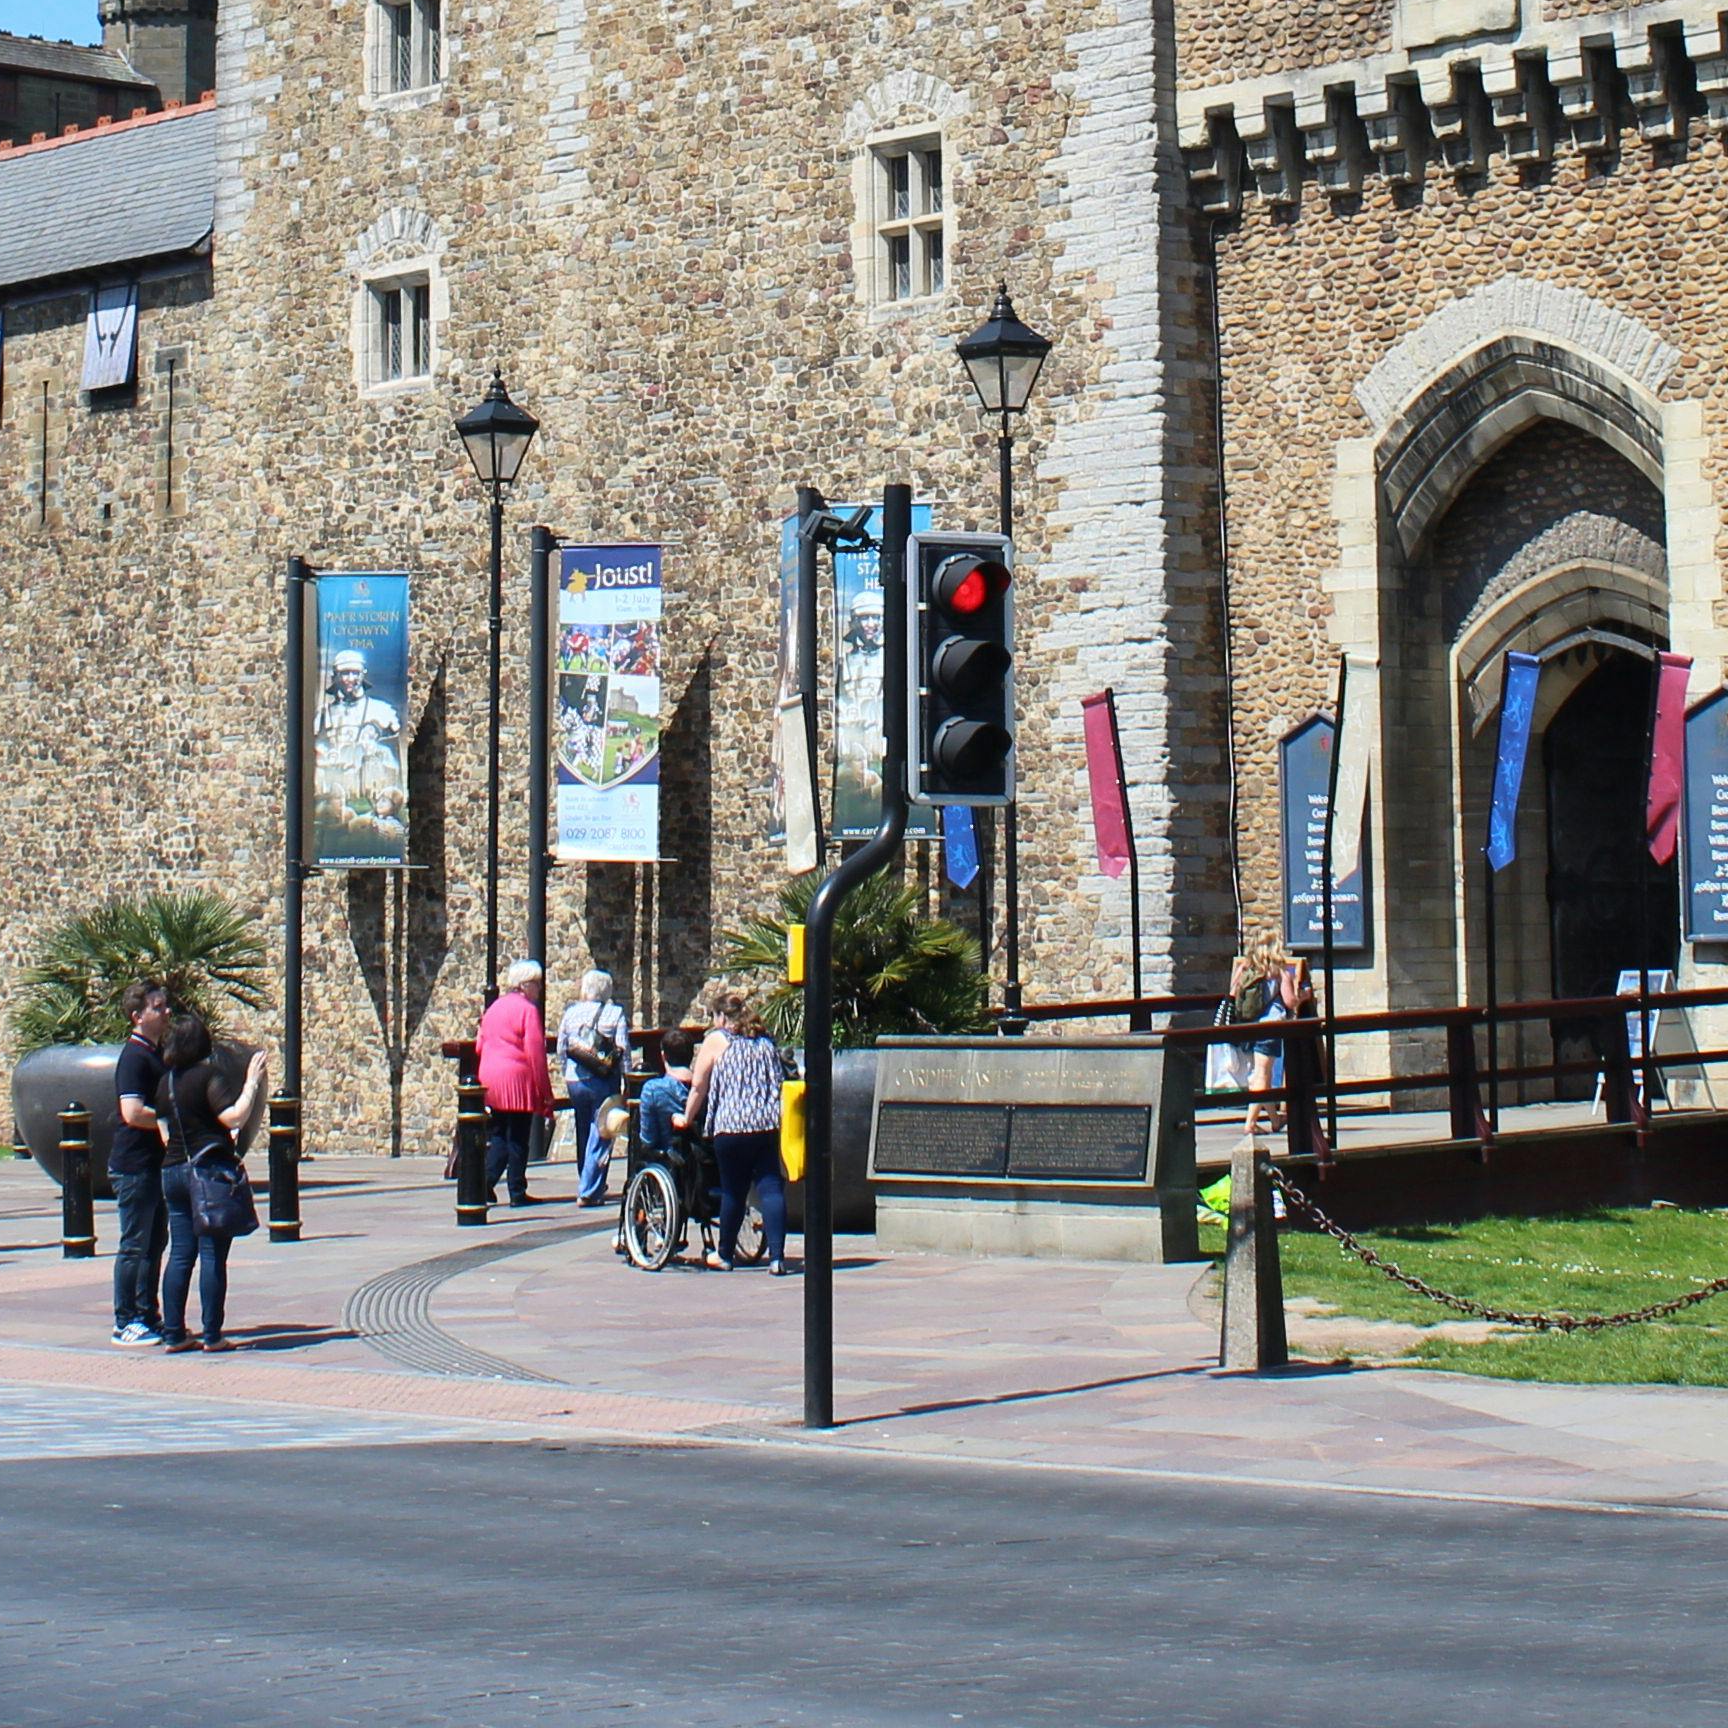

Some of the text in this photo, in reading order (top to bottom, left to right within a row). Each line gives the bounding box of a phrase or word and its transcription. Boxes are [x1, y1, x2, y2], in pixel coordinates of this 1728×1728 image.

[857, 562, 881, 575] STA
[594, 561, 653, 590] Joust!
[333, 624, 389, 636] CYCHWYN
[566, 827, 588, 840] 029
